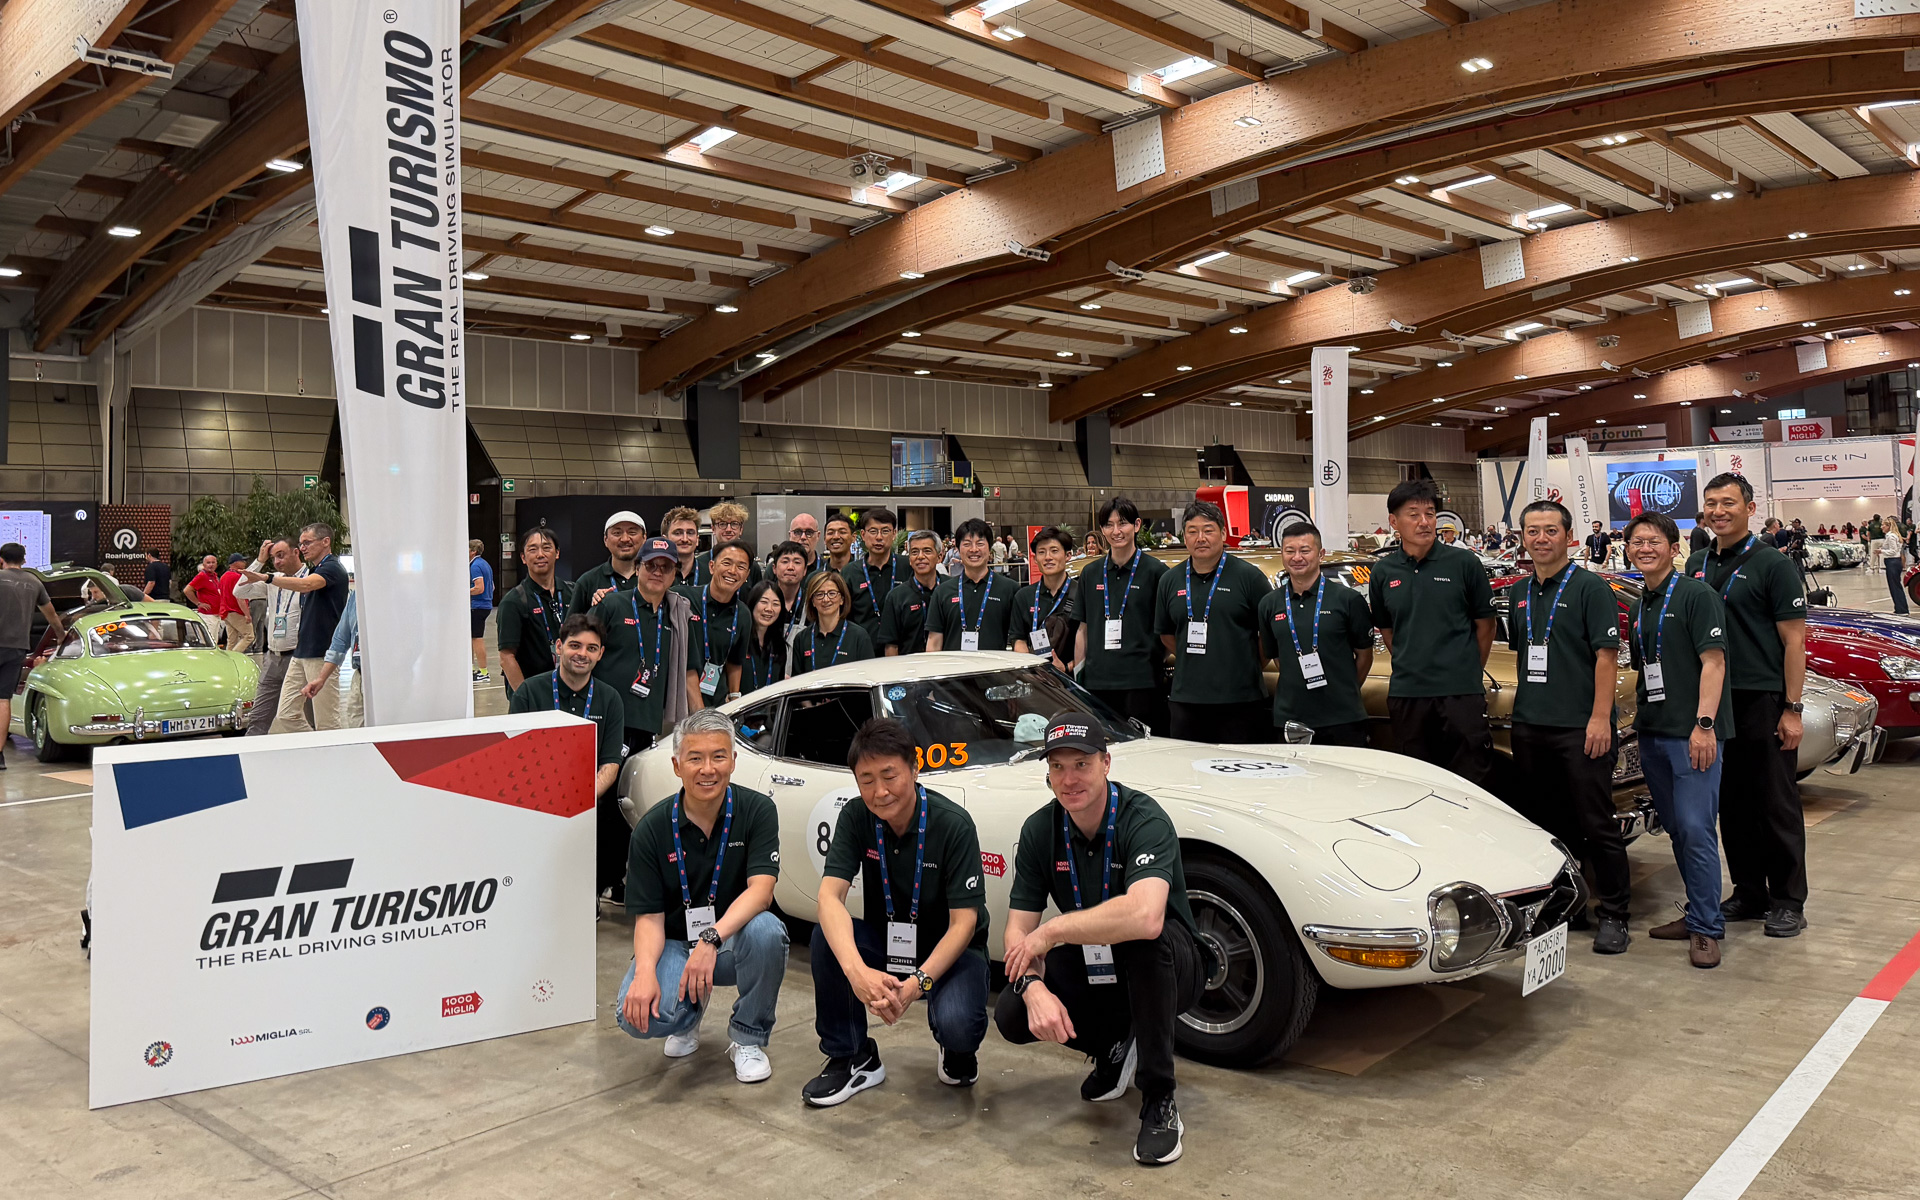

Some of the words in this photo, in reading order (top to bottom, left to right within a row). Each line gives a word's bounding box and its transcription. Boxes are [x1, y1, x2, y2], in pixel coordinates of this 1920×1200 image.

[441, 47, 456, 186] SIMULATOR
[383, 30, 440, 253] TURISMO
[446, 192, 458, 290] DRIVING
[393, 266, 446, 409] GRAN
[449, 296, 459, 359] REAL
[451, 365, 460, 413] THE
[1602, 428, 1643, 440] forum
[1795, 454, 1838, 463] CHECK
[1844, 453, 1867, 461] IN
[1264, 493, 1295, 503] CHOPARD
[105, 552, 145, 560] Roarington
[170, 720, 183, 732] WM
[981, 853, 1000, 864] 000
[200, 900, 319, 950] GRAN
[330, 877, 499, 933] TURISMO
[195, 952, 236, 970] THE
[242, 946, 293, 964] REAL
[298, 934, 376, 956] DRIVING
[382, 918, 487, 944] SIMULATOR
[1528, 967, 1537, 985] YA
[1538, 945, 1565, 985] 2000
[443, 1003, 476, 1016] MIGLIA
[445, 994, 473, 1006] 1000
